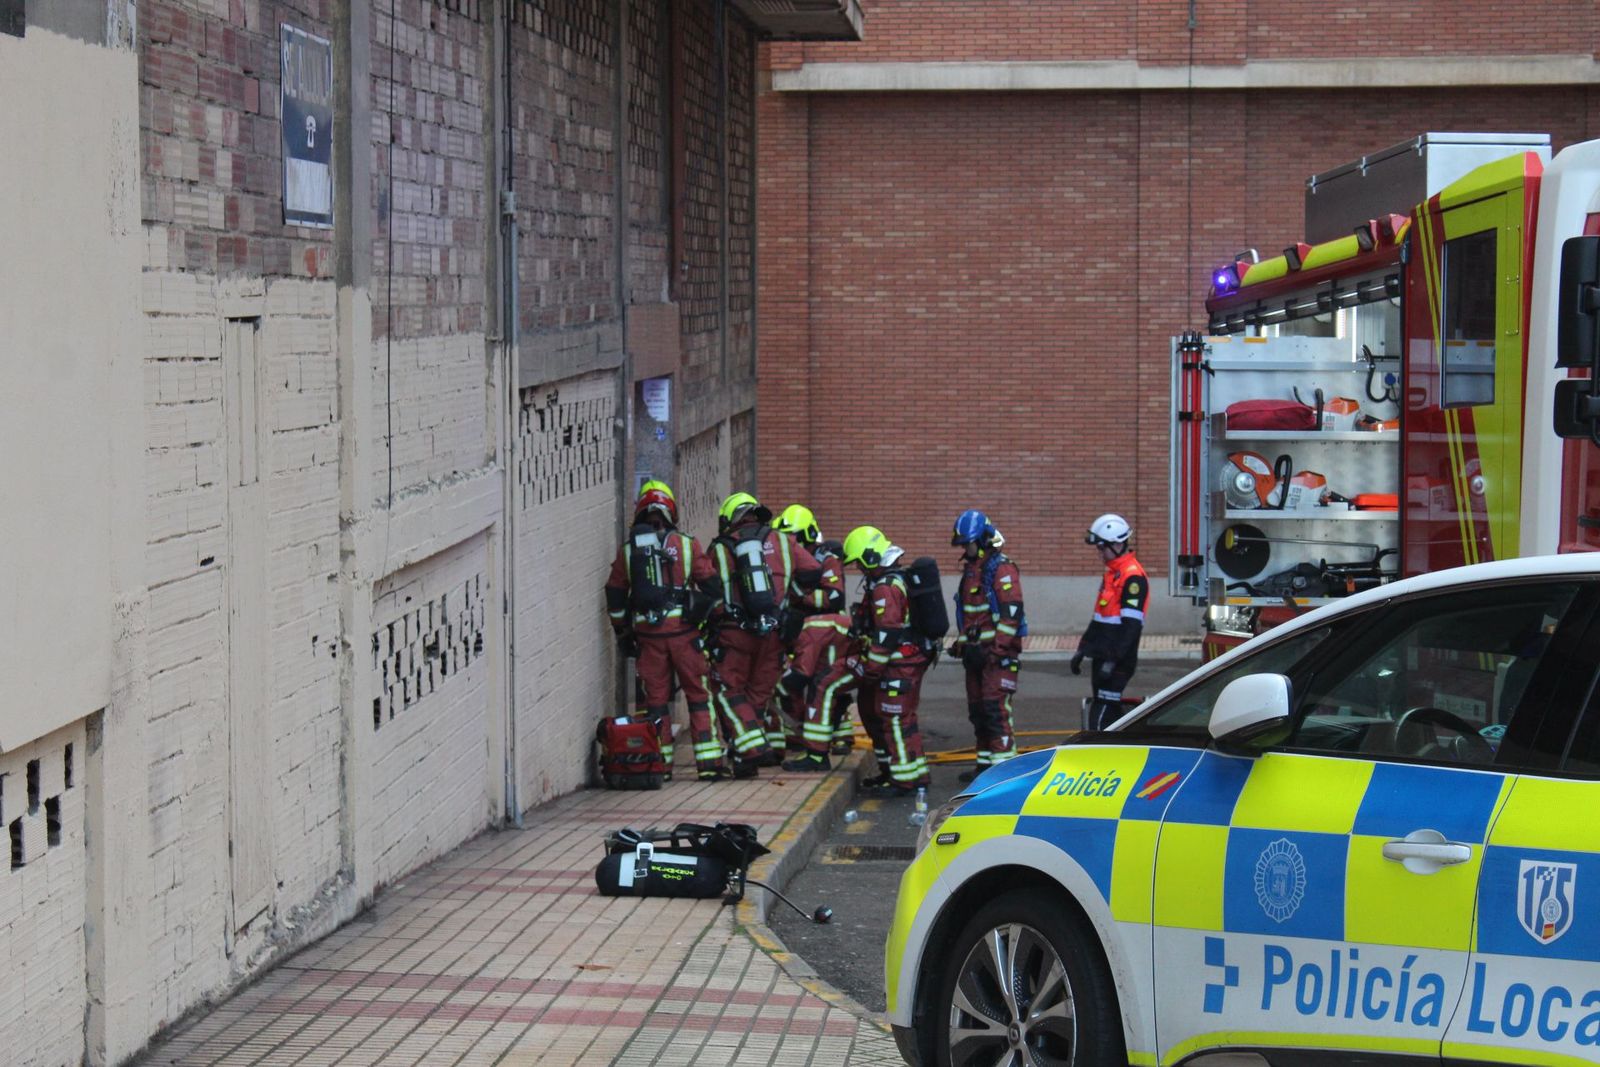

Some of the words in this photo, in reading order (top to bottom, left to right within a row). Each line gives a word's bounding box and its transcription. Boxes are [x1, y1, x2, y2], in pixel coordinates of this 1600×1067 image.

[1042, 770, 1122, 797] Policía
[1523, 866, 1573, 938] 175
[1260, 944, 1446, 1028] Policía
[1466, 961, 1600, 1047] Loca
